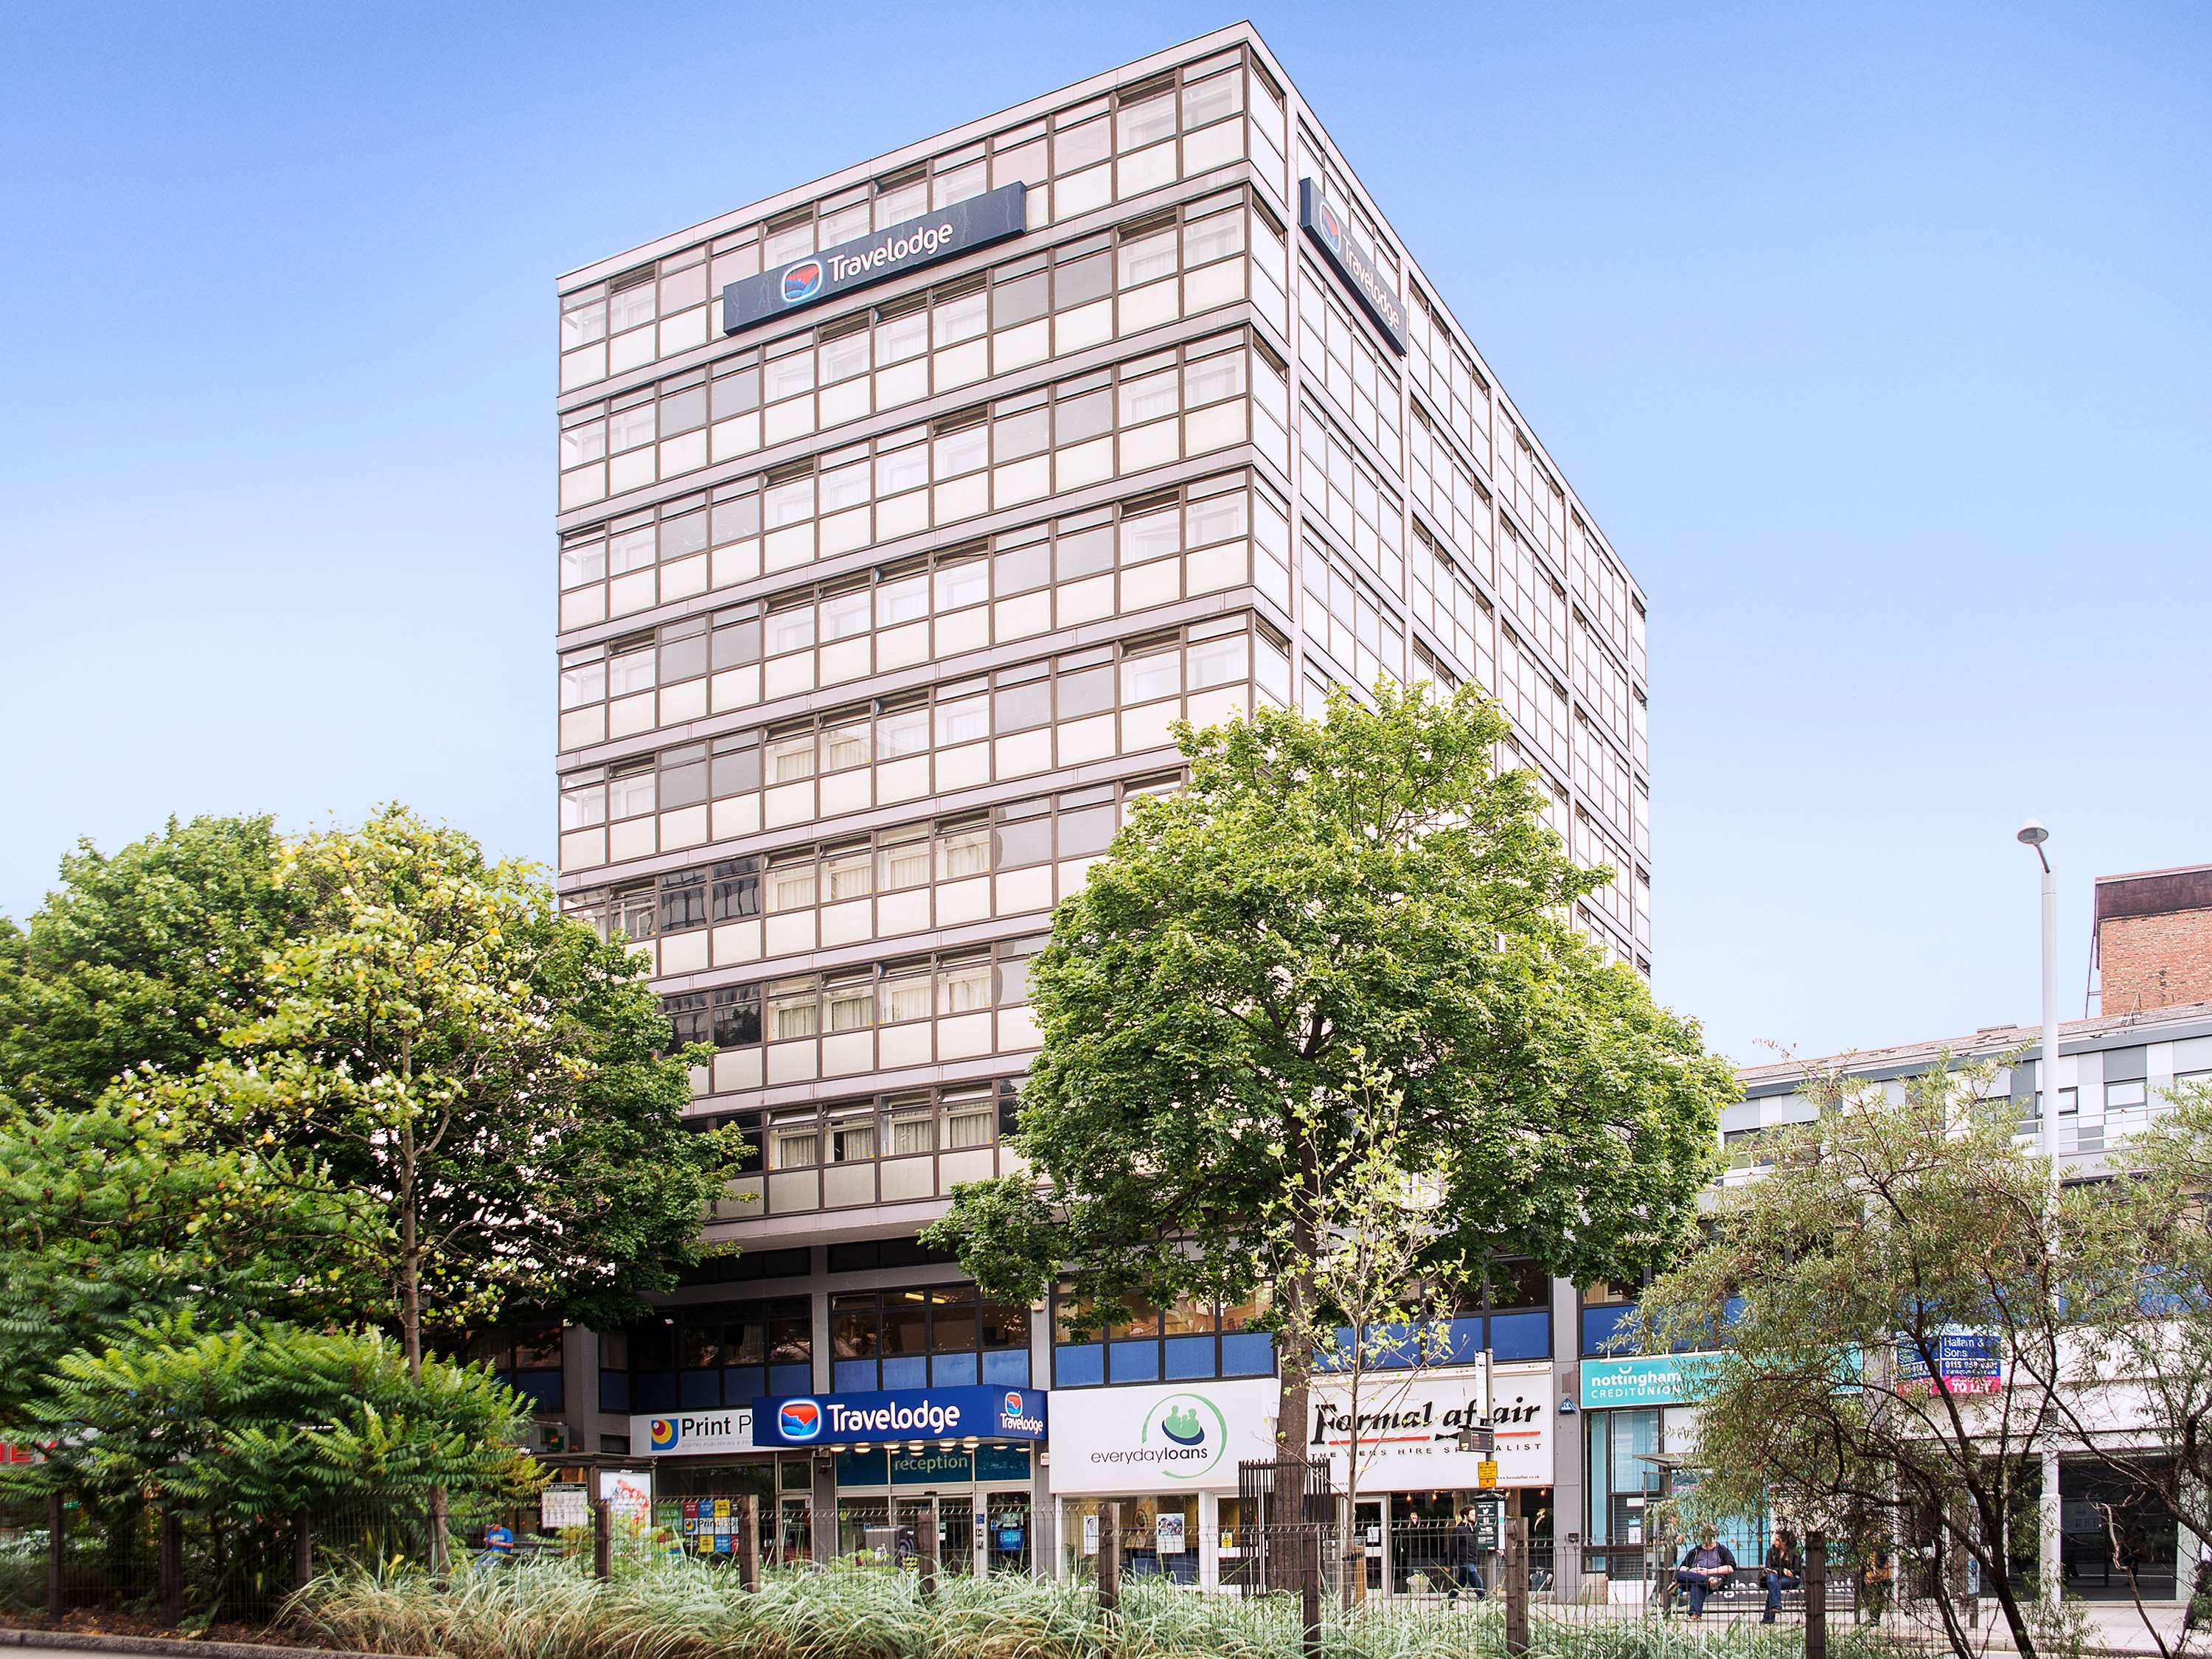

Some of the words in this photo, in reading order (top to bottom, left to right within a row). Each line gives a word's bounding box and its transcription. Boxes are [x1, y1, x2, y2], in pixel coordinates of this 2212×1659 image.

[827, 223, 954, 283] Travelodge
[1342, 233, 1400, 330] Travelodge
[1944, 1347, 1968, 1357] Sons
[1591, 1367, 1682, 1387] nottingham
[1951, 1382, 1967, 1393] TO
[681, 1416, 731, 1437] Print
[826, 1399, 961, 1434] Travelodge
[1000, 1413, 1044, 1435] Travelodge
[1310, 1401, 1433, 1445] Formal
[1442, 1396, 1542, 1427] afair
[1091, 1447, 1208, 1465] everydayloans
[1311, 1451, 1337, 1459] THE
[1346, 1449, 1387, 1457] ENS
[1397, 1447, 1433, 1455] HIRE
[894, 1454, 968, 1473] reception
